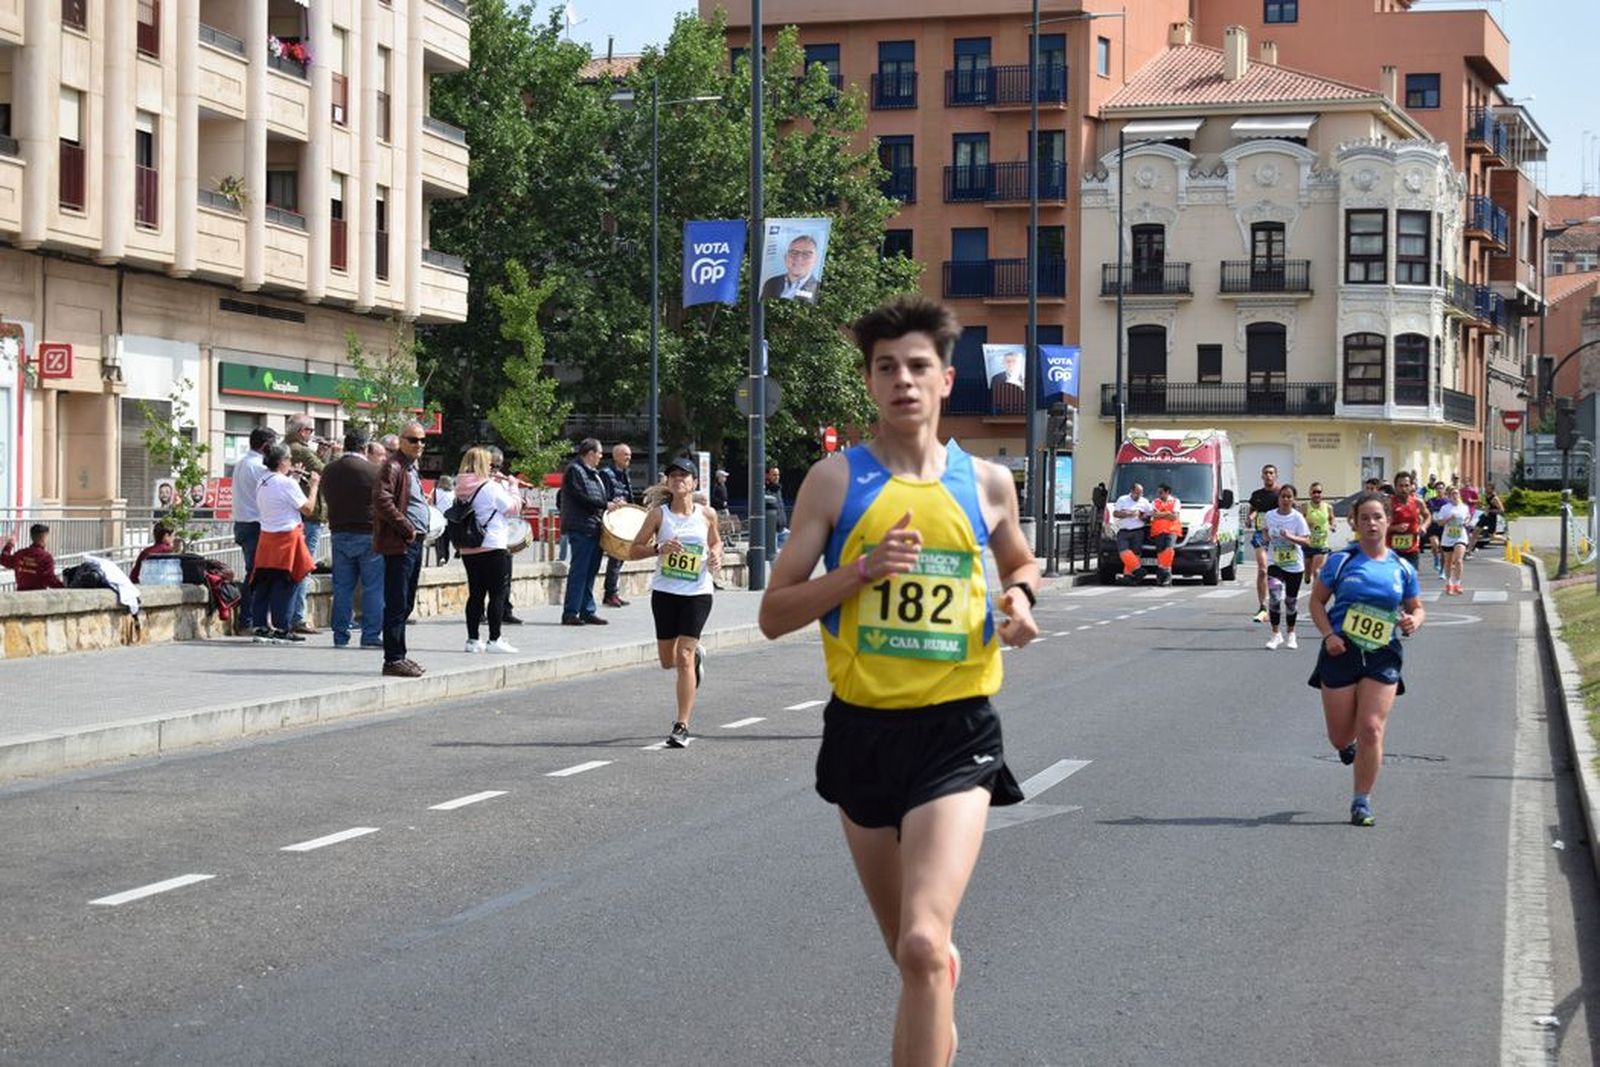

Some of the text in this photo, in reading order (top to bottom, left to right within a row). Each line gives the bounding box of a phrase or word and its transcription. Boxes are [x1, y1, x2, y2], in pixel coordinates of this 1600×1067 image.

[693, 242, 730, 255] VOTA
[1047, 357, 1073, 365] VOTA
[668, 553, 696, 571] 661
[873, 579, 953, 624] 182
[1351, 614, 1385, 640] 198
[923, 638, 961, 652] RURAL
